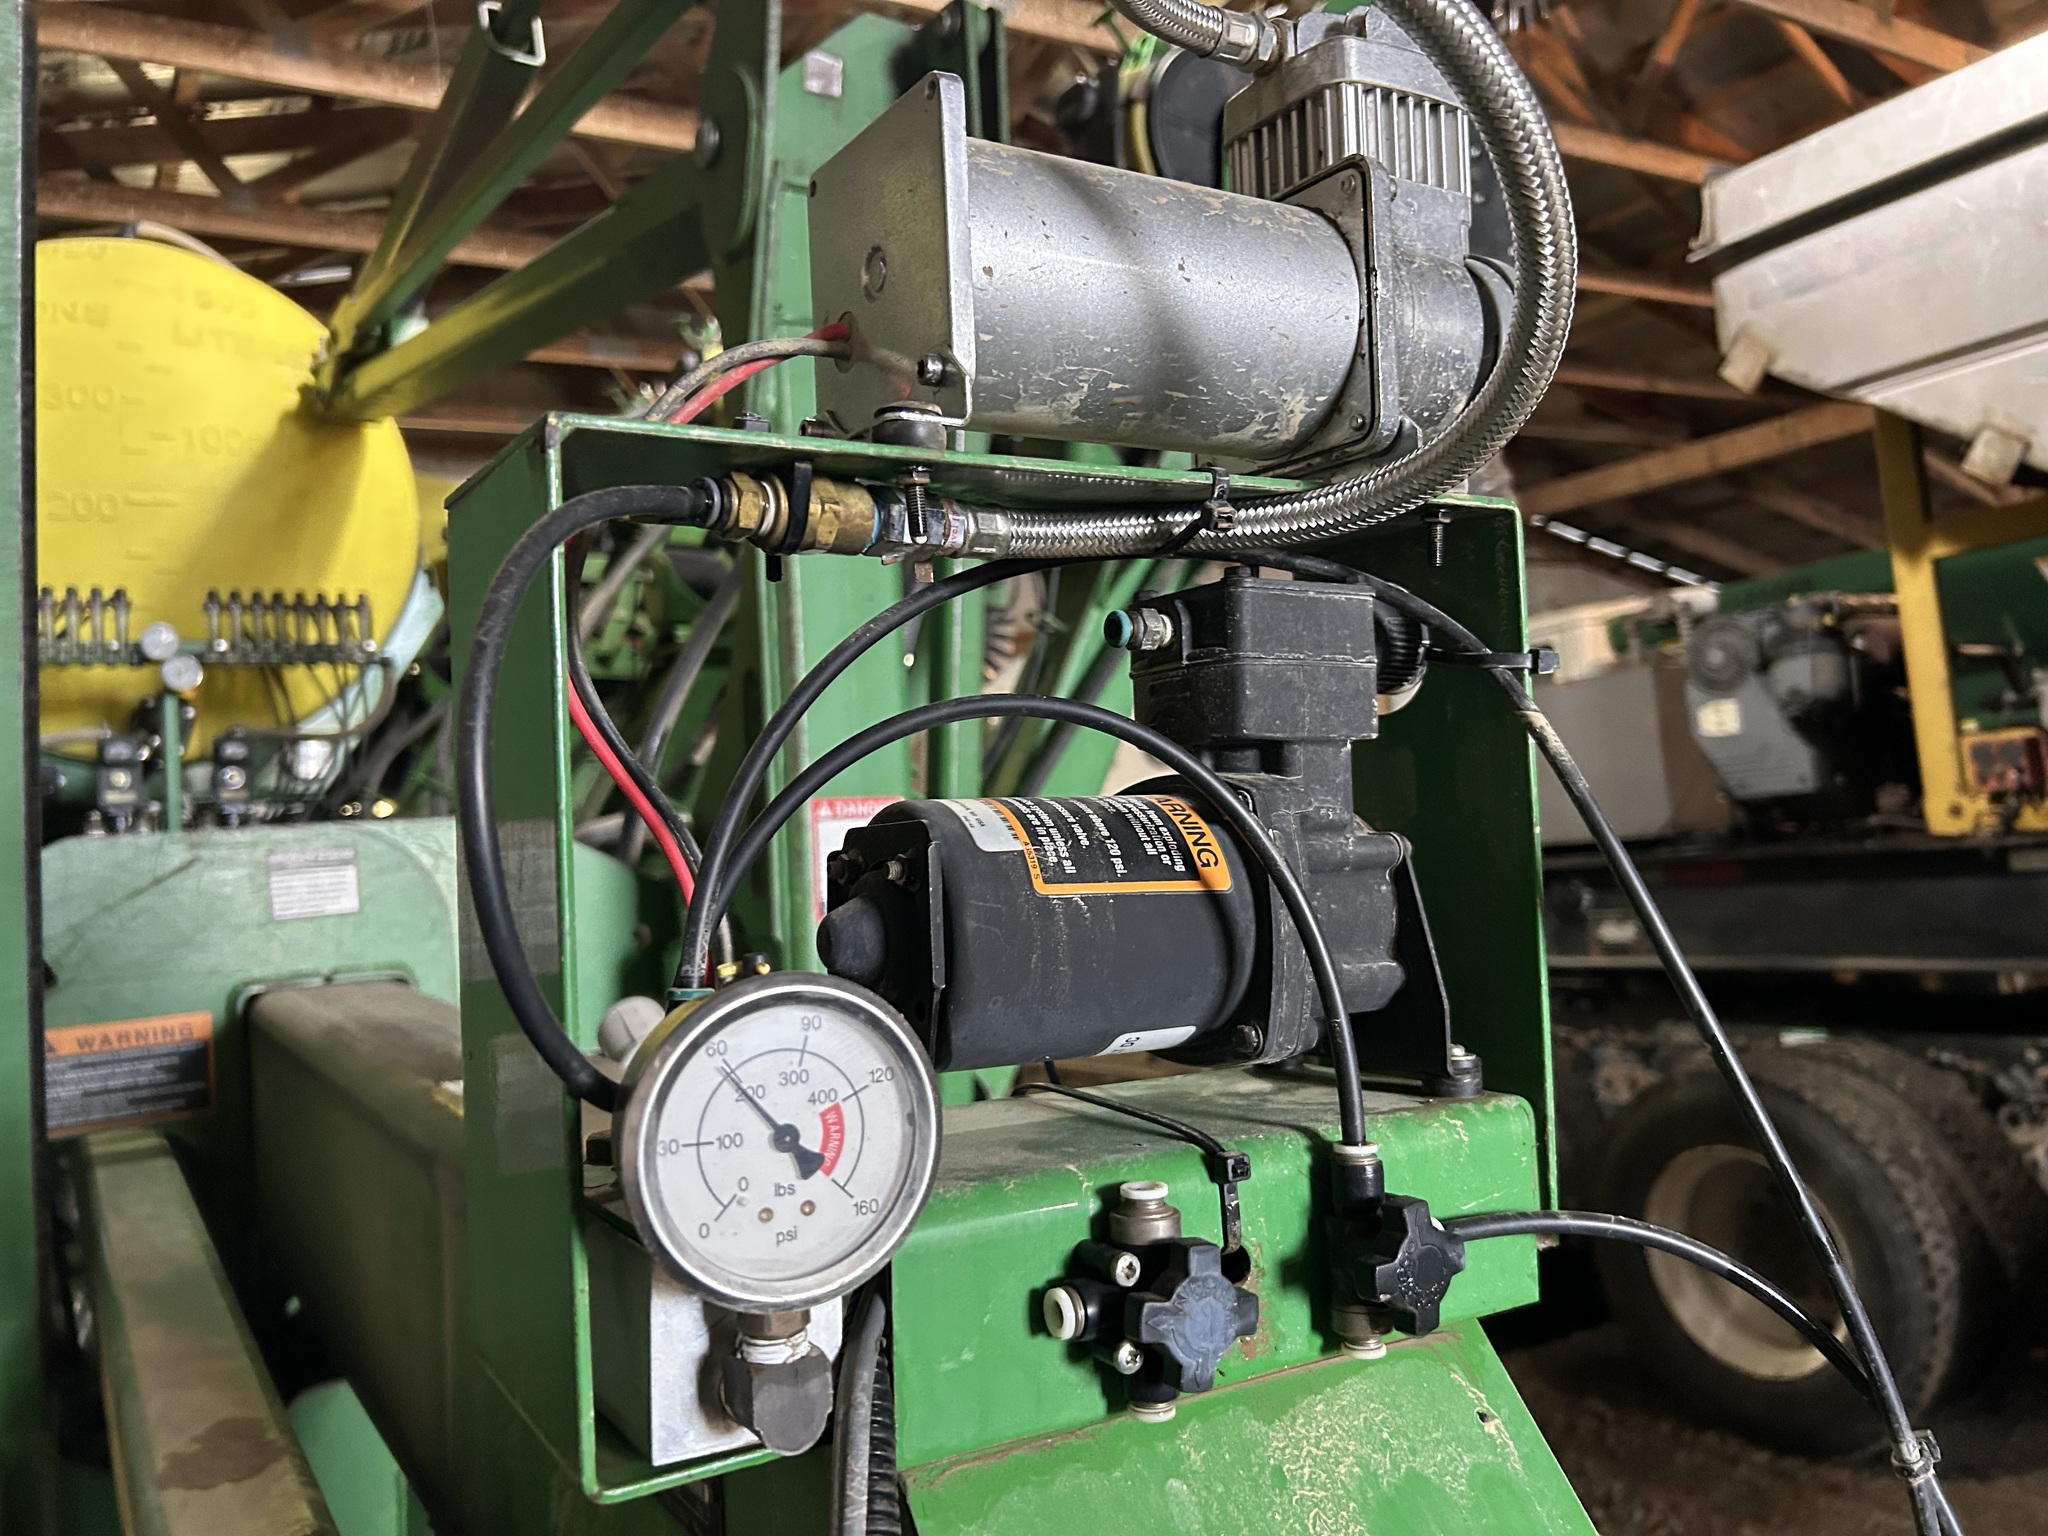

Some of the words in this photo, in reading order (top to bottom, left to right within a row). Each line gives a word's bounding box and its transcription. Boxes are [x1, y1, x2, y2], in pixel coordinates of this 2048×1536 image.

[1026, 813, 1041, 826] are
[1030, 805, 1054, 827] system
[1048, 827, 1069, 858] unless
[1062, 859, 1077, 874] all
[1035, 826, 1047, 835] in
[1071, 823, 1090, 849] valve.
[1089, 814, 1111, 837] above
[1105, 838, 1121, 856] 120
[1125, 813, 1151, 842] without
[1143, 842, 1159, 855] all
[1145, 810, 1164, 826] from
[1159, 827, 1186, 872] exploding
[1038, 836, 1058, 867] place.
[1161, 854, 1172, 866] or
[801, 1015, 822, 1031] 90
[76, 1022, 196, 1051] WARNING
[705, 1040, 728, 1057] 60
[779, 1069, 810, 1087] 300
[869, 1066, 894, 1084] 120
[735, 1084, 766, 1102] 200
[808, 1088, 838, 1105] 400
[657, 1139, 679, 1155] 30
[716, 1132, 744, 1150] 100
[825, 1110, 841, 1166] WARNING
[738, 1176, 749, 1191] 0
[774, 1182, 796, 1197] lbs
[852, 1198, 879, 1215] 160
[699, 1223, 710, 1239] 0
[776, 1226, 798, 1246] psi
